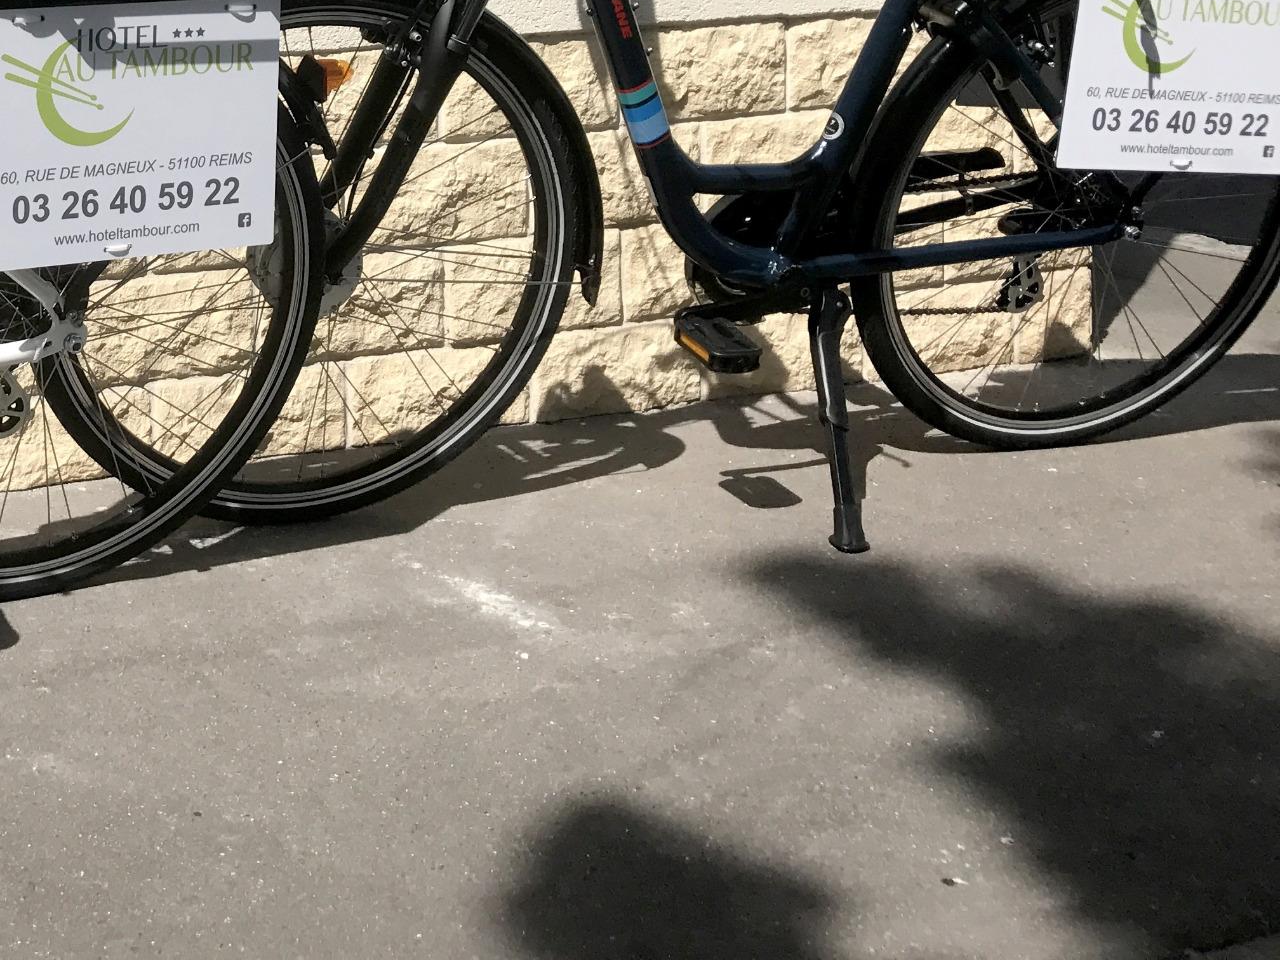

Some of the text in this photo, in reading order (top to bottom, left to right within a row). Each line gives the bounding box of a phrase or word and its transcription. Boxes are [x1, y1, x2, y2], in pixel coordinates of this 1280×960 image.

[77, 23, 168, 52] HOTEL
[56, 41, 254, 83] AU TAMBOUR
[1086, 86, 1102, 99] 60,
[1105, 88, 1130, 100] RUE
[1131, 88, 1149, 100] DE
[1151, 89, 1209, 103] MAGNEUX
[1215, 91, 1246, 105] 51100
[1092, 107, 1270, 138] 03 26 40 59 22
[1120, 143, 1234, 158] www.hoteltambour.com
[0, 171, 20, 186] 60,
[24, 167, 57, 183] RUE
[59, 165, 81, 181] DE
[84, 159, 157, 178] MAGNEUX
[167, 154, 207, 171] 51100
[208, 151, 253, 167] REIMS
[12, 176, 241, 224] 03 26 40 59 22
[53, 220, 201, 246] www.hoteltambour.com
